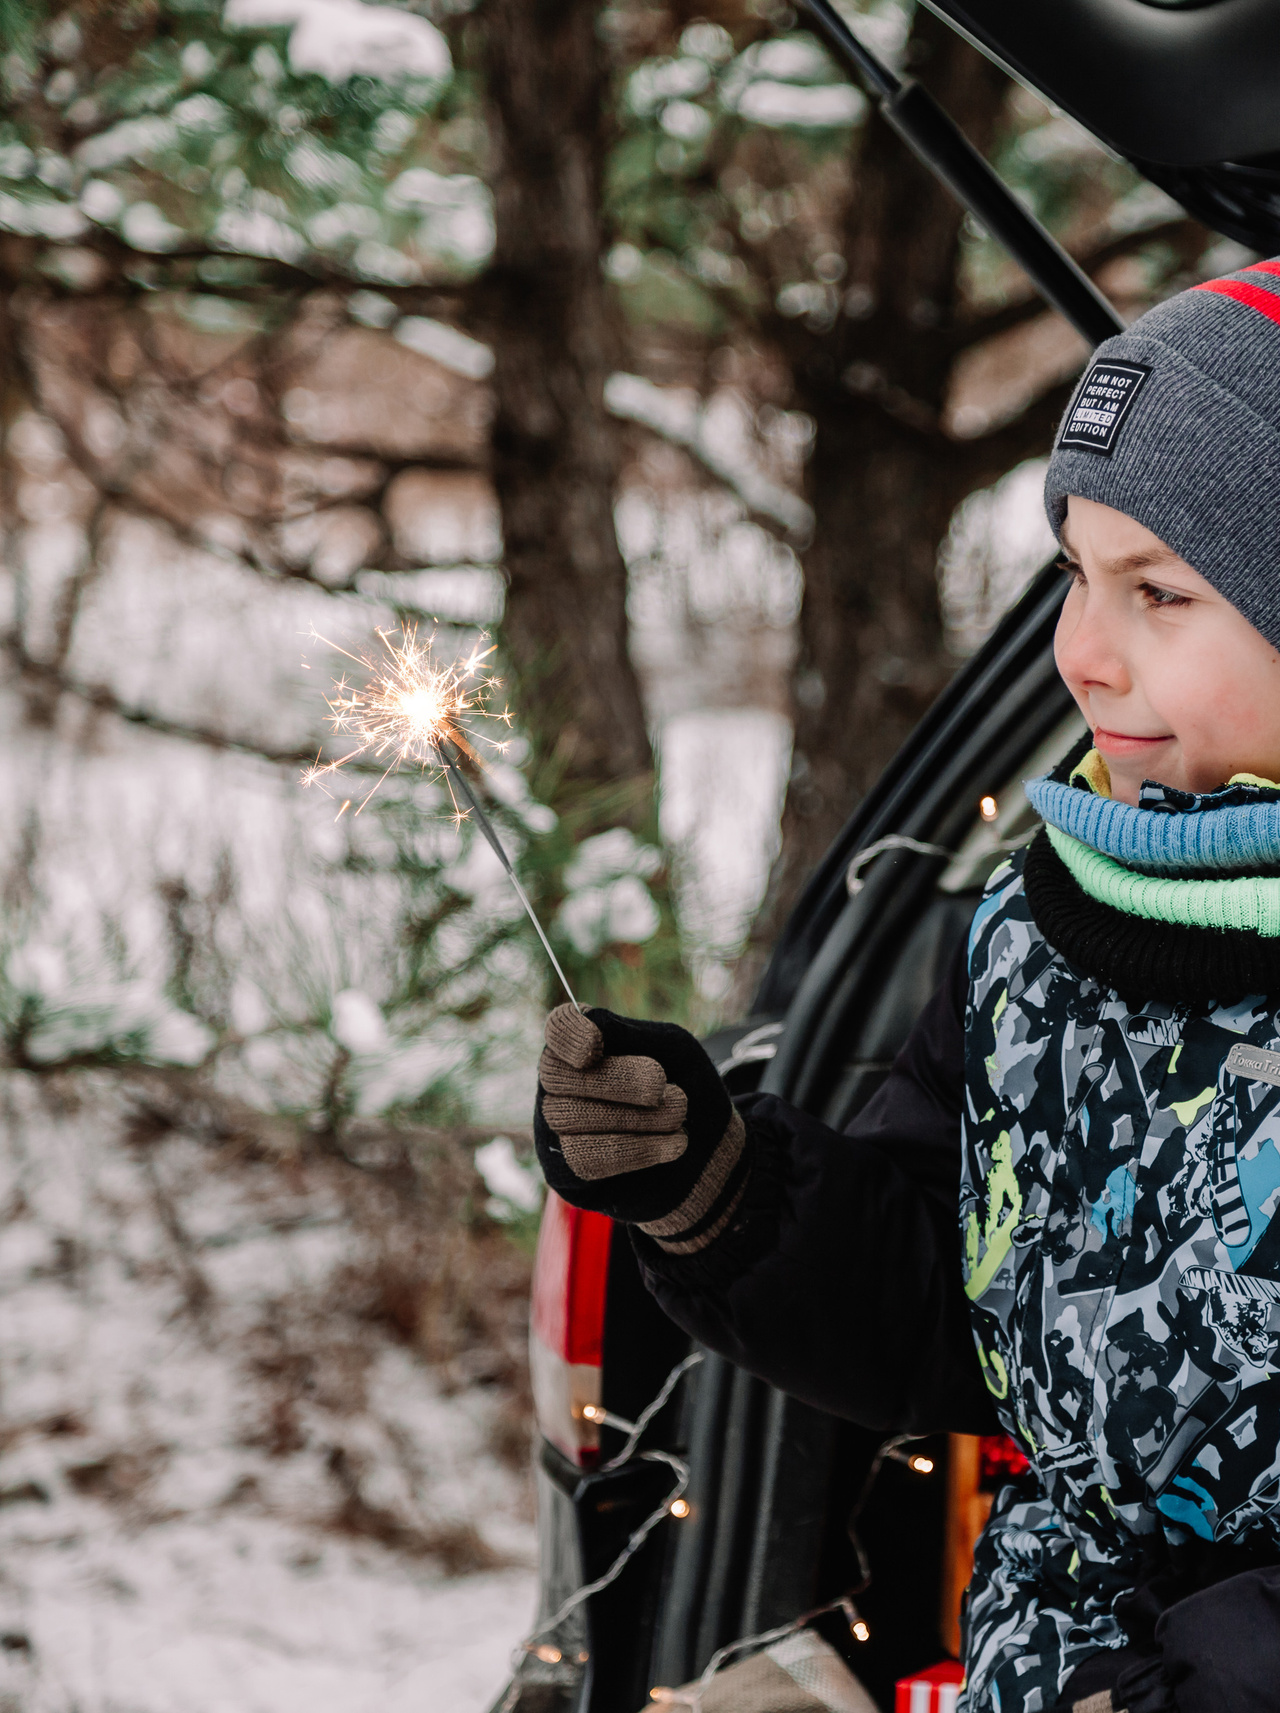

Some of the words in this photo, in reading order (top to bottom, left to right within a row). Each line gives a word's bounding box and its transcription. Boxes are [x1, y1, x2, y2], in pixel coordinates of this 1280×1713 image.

[1091, 374, 1097, 383] I
[1097, 374, 1110, 385] AM
[1110, 376, 1132, 388] NOT
[1086, 385, 1126, 400] PERFECT
[1080, 397, 1097, 408] BUT
[1103, 401, 1120, 412] AM
[1075, 410, 1112, 424] LIMITED
[1069, 422, 1108, 437] EDITION
